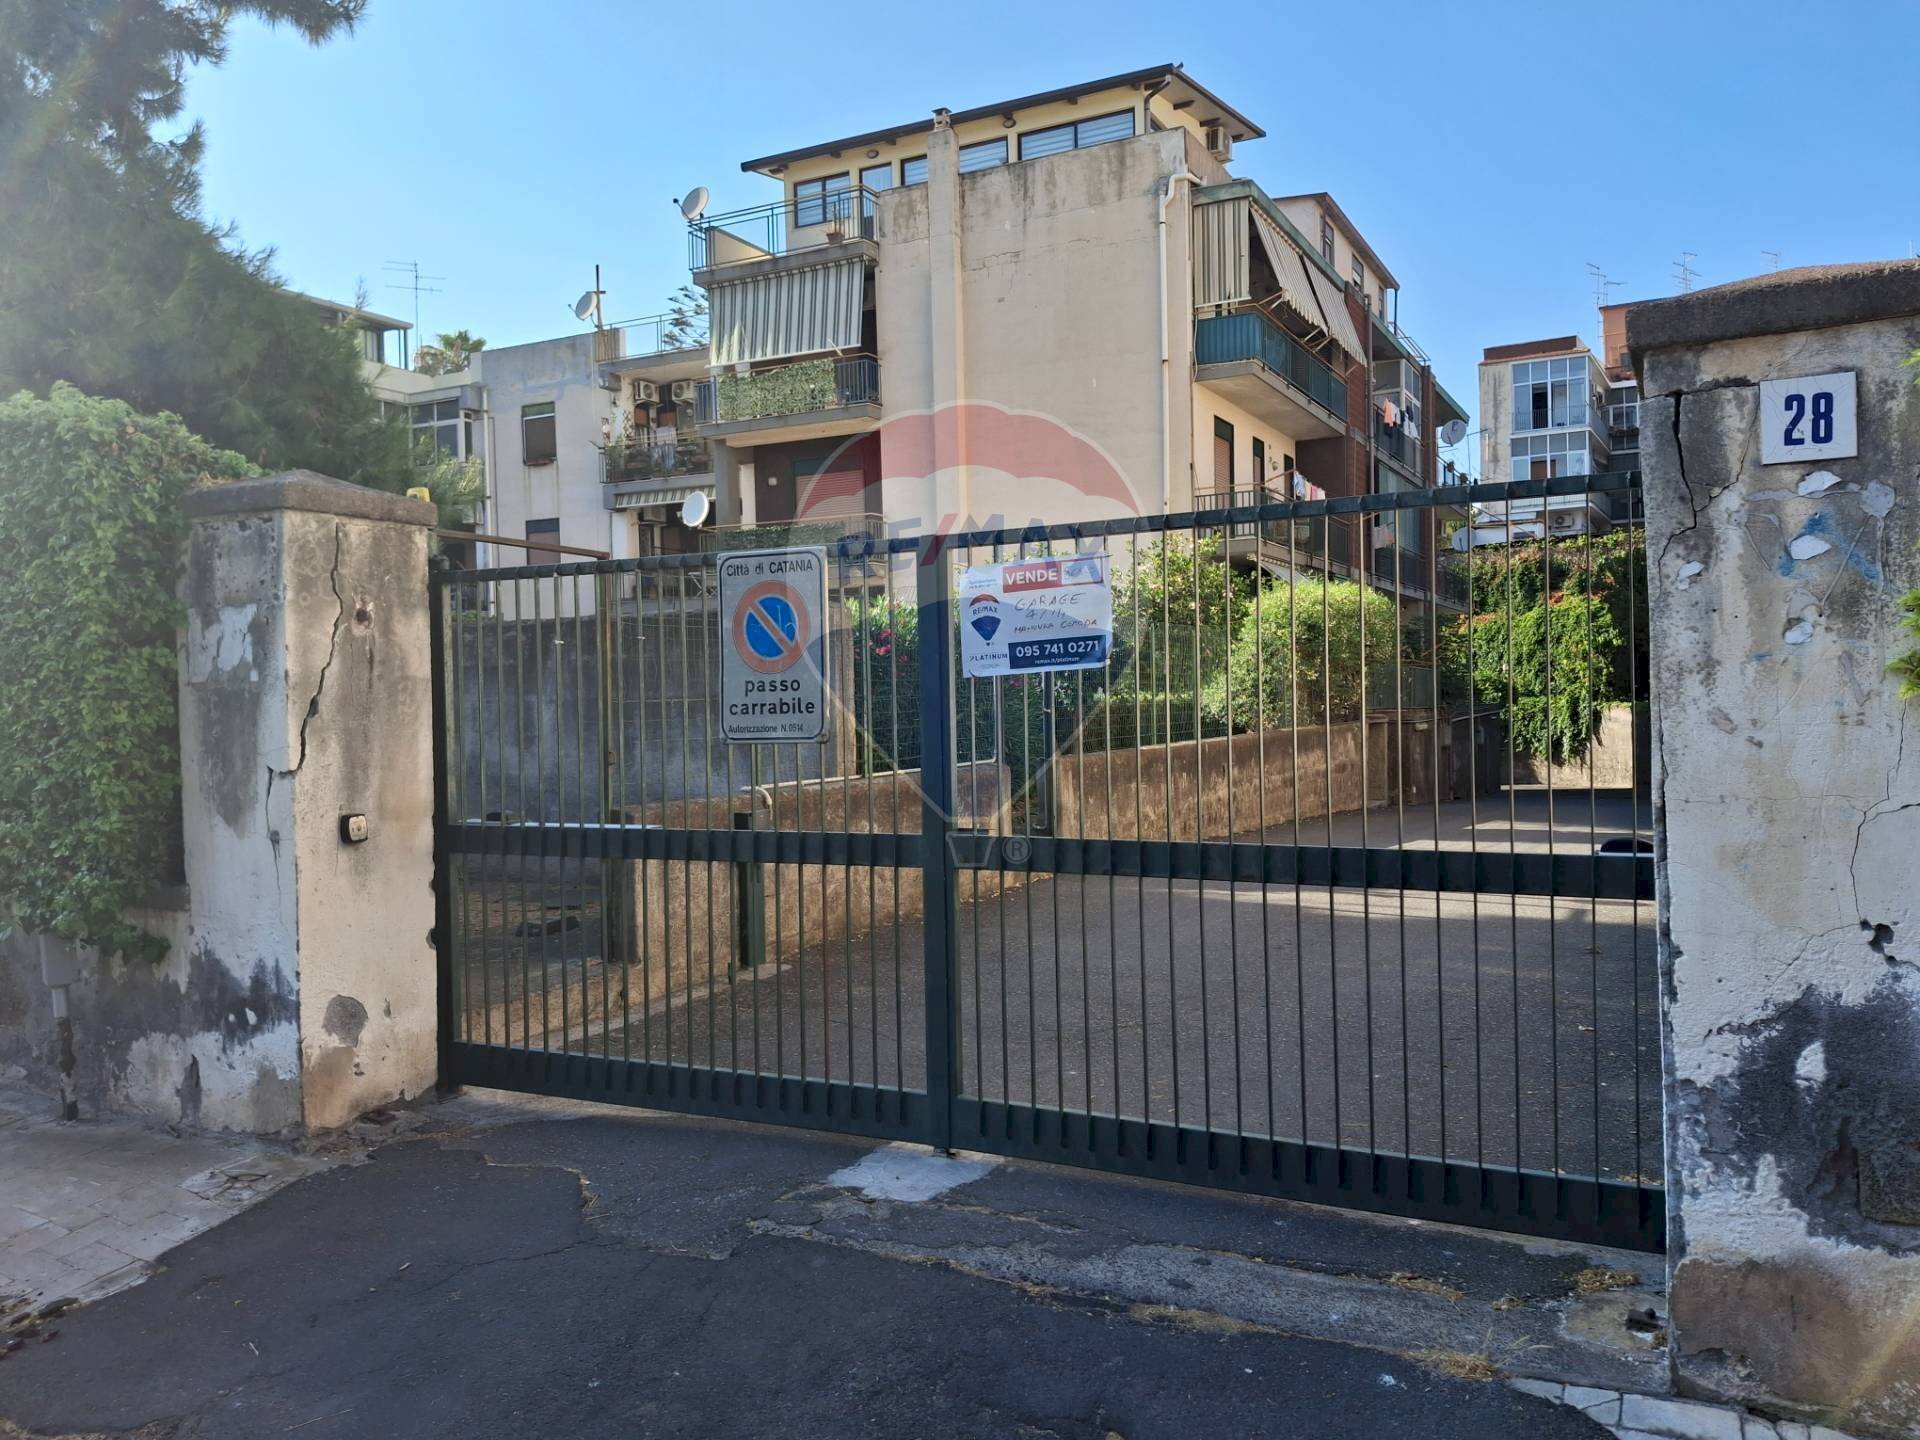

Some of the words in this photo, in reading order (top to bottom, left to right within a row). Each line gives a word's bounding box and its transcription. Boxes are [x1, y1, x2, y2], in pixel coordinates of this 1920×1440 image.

[1784, 392, 1834, 446] 28
[726, 564, 750, 577] Città
[754, 563, 765, 575] di
[769, 560, 814, 574] CATANIA
[1006, 569, 1058, 585] VENDE
[1014, 593, 1087, 611] GARAGE
[972, 606, 998, 616] RE/MAX
[969, 653, 1008, 662] PLATINUM
[1015, 646, 1041, 658] 095
[1044, 643, 1065, 655] 741
[1067, 640, 1100, 653] 0271
[744, 679, 801, 697] passo
[729, 697, 816, 716] carrabile
[728, 724, 778, 734] Autorizzazione
